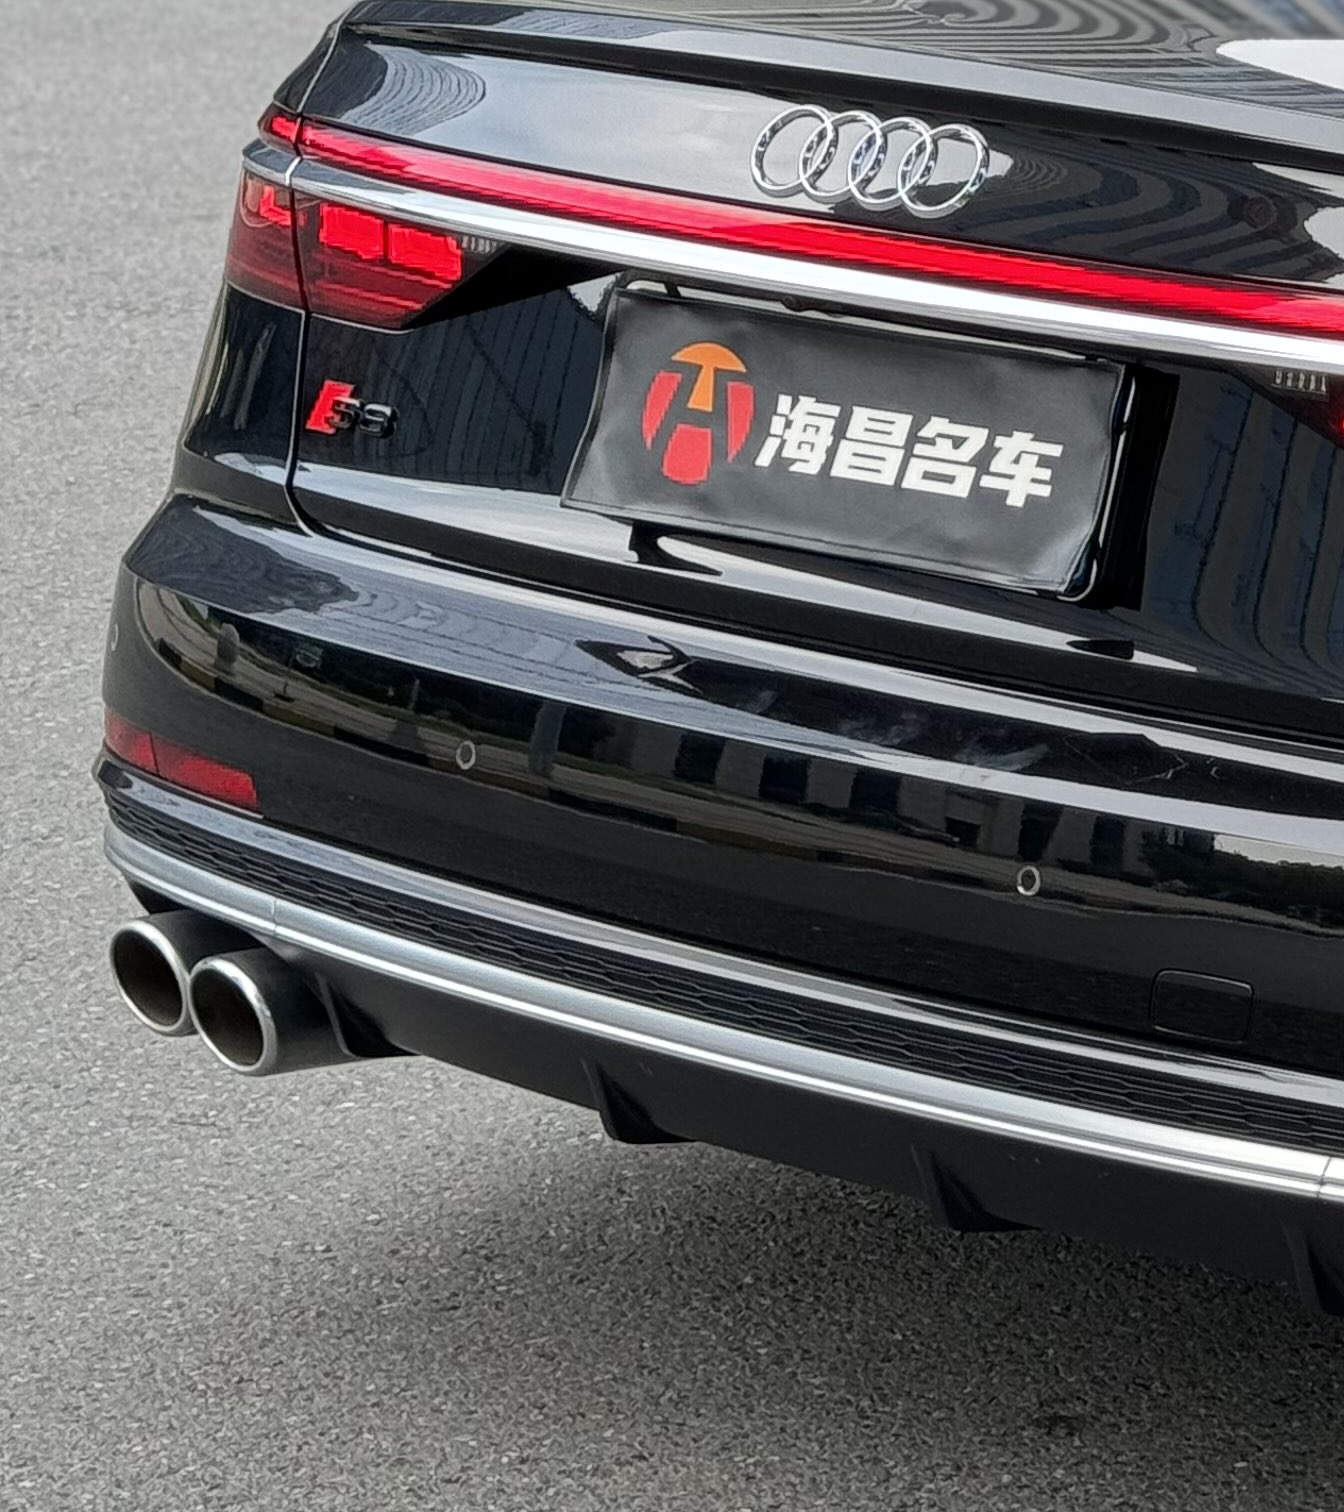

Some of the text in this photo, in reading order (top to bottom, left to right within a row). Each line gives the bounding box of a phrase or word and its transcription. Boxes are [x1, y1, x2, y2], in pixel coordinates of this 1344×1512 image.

[316, 388, 397, 437] S8
[754, 394, 1064, 508] 海昌名车
